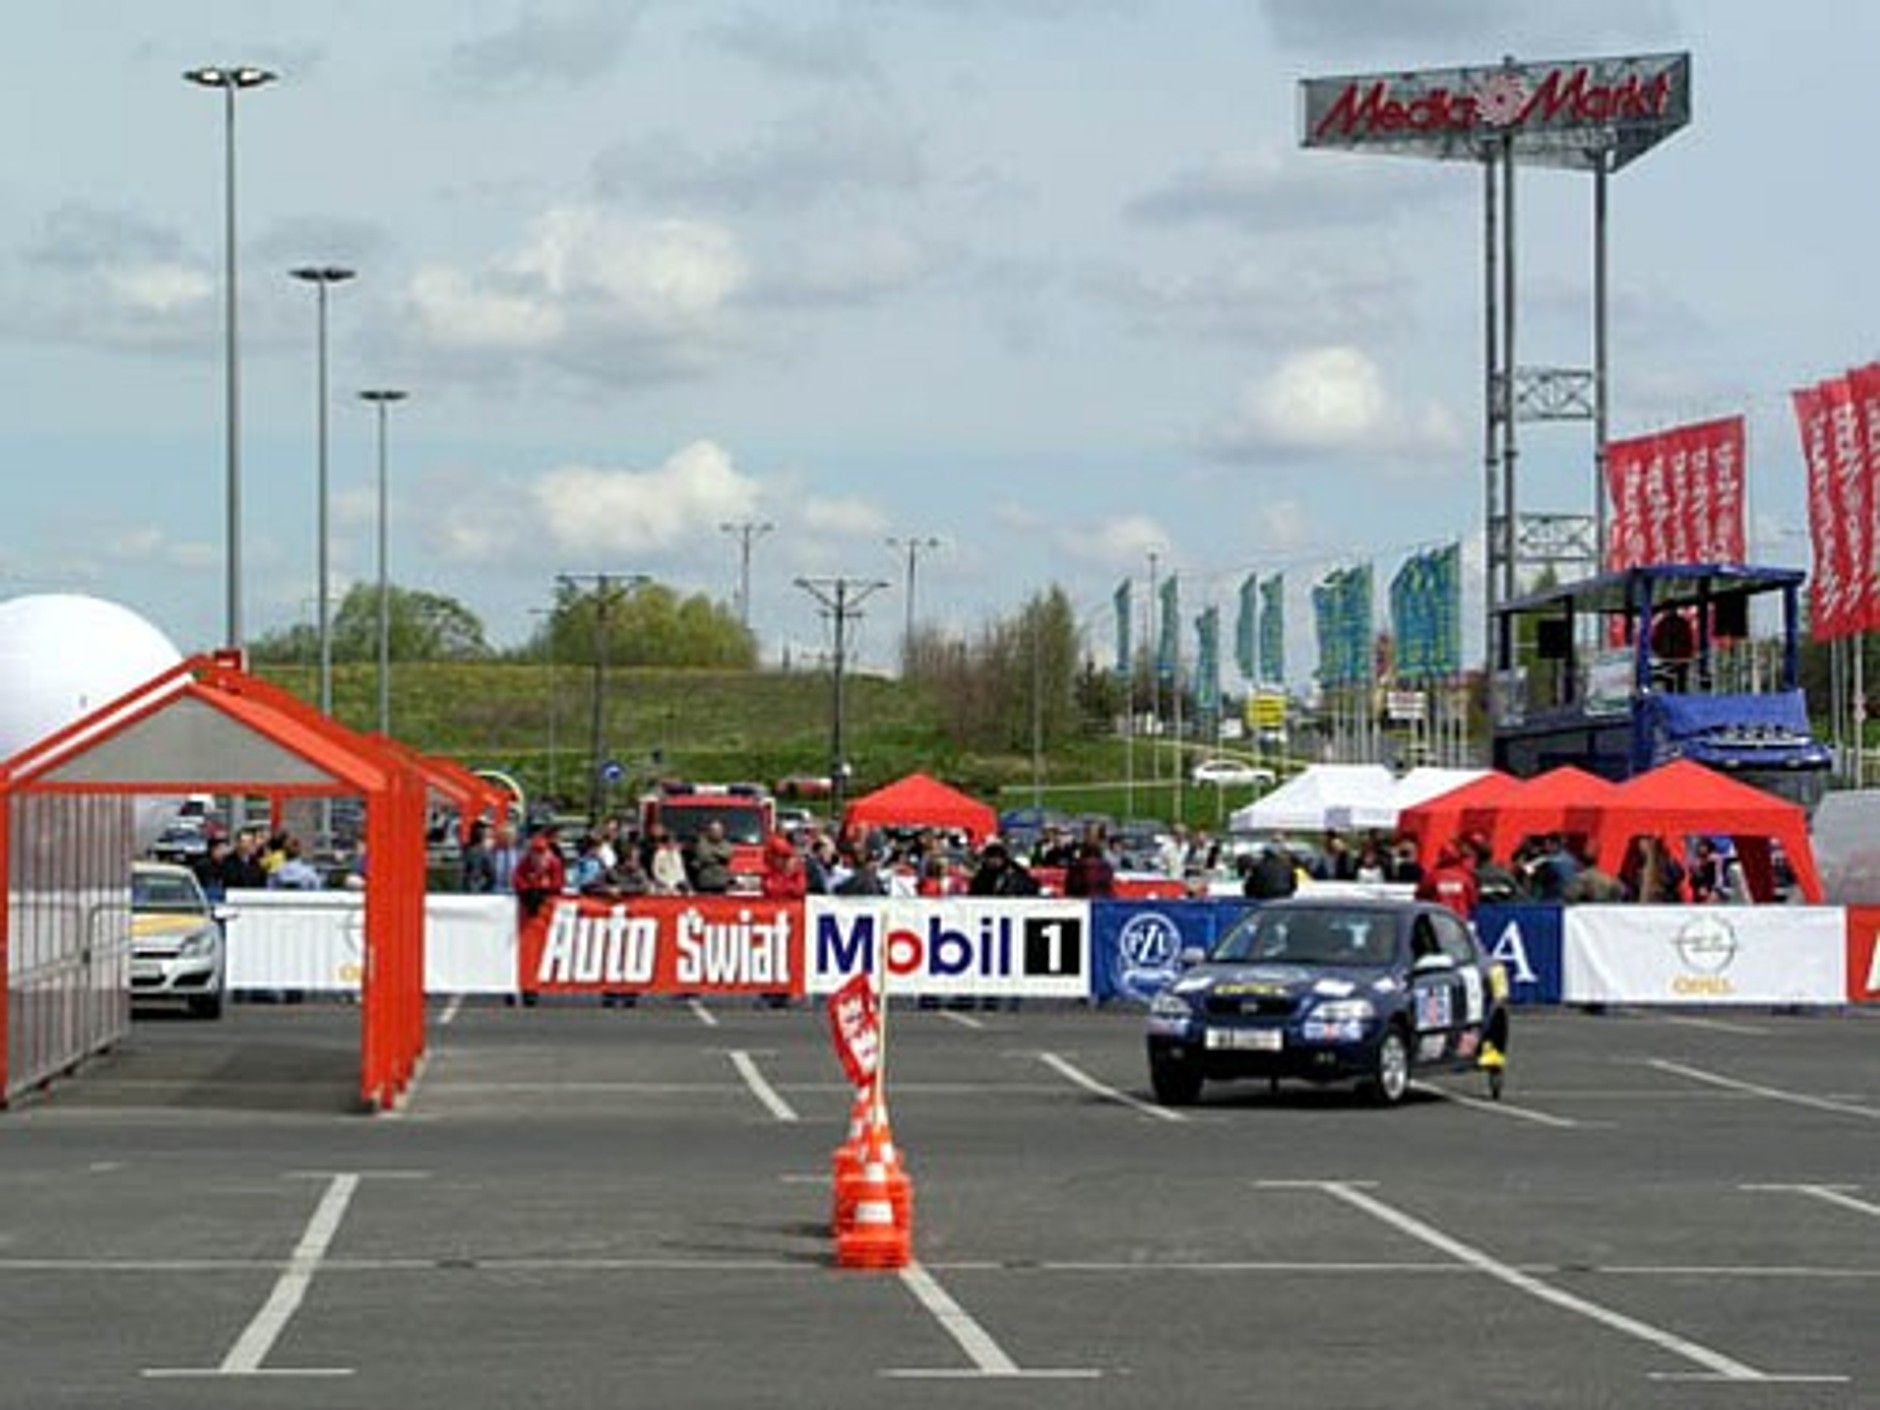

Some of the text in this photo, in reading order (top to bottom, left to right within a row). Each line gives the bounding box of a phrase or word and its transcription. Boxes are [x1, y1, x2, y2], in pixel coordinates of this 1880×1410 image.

[1315, 67, 1671, 139] Media Markt
[537, 902, 657, 985] Auto
[816, 914, 1064, 976] Mobil 1
